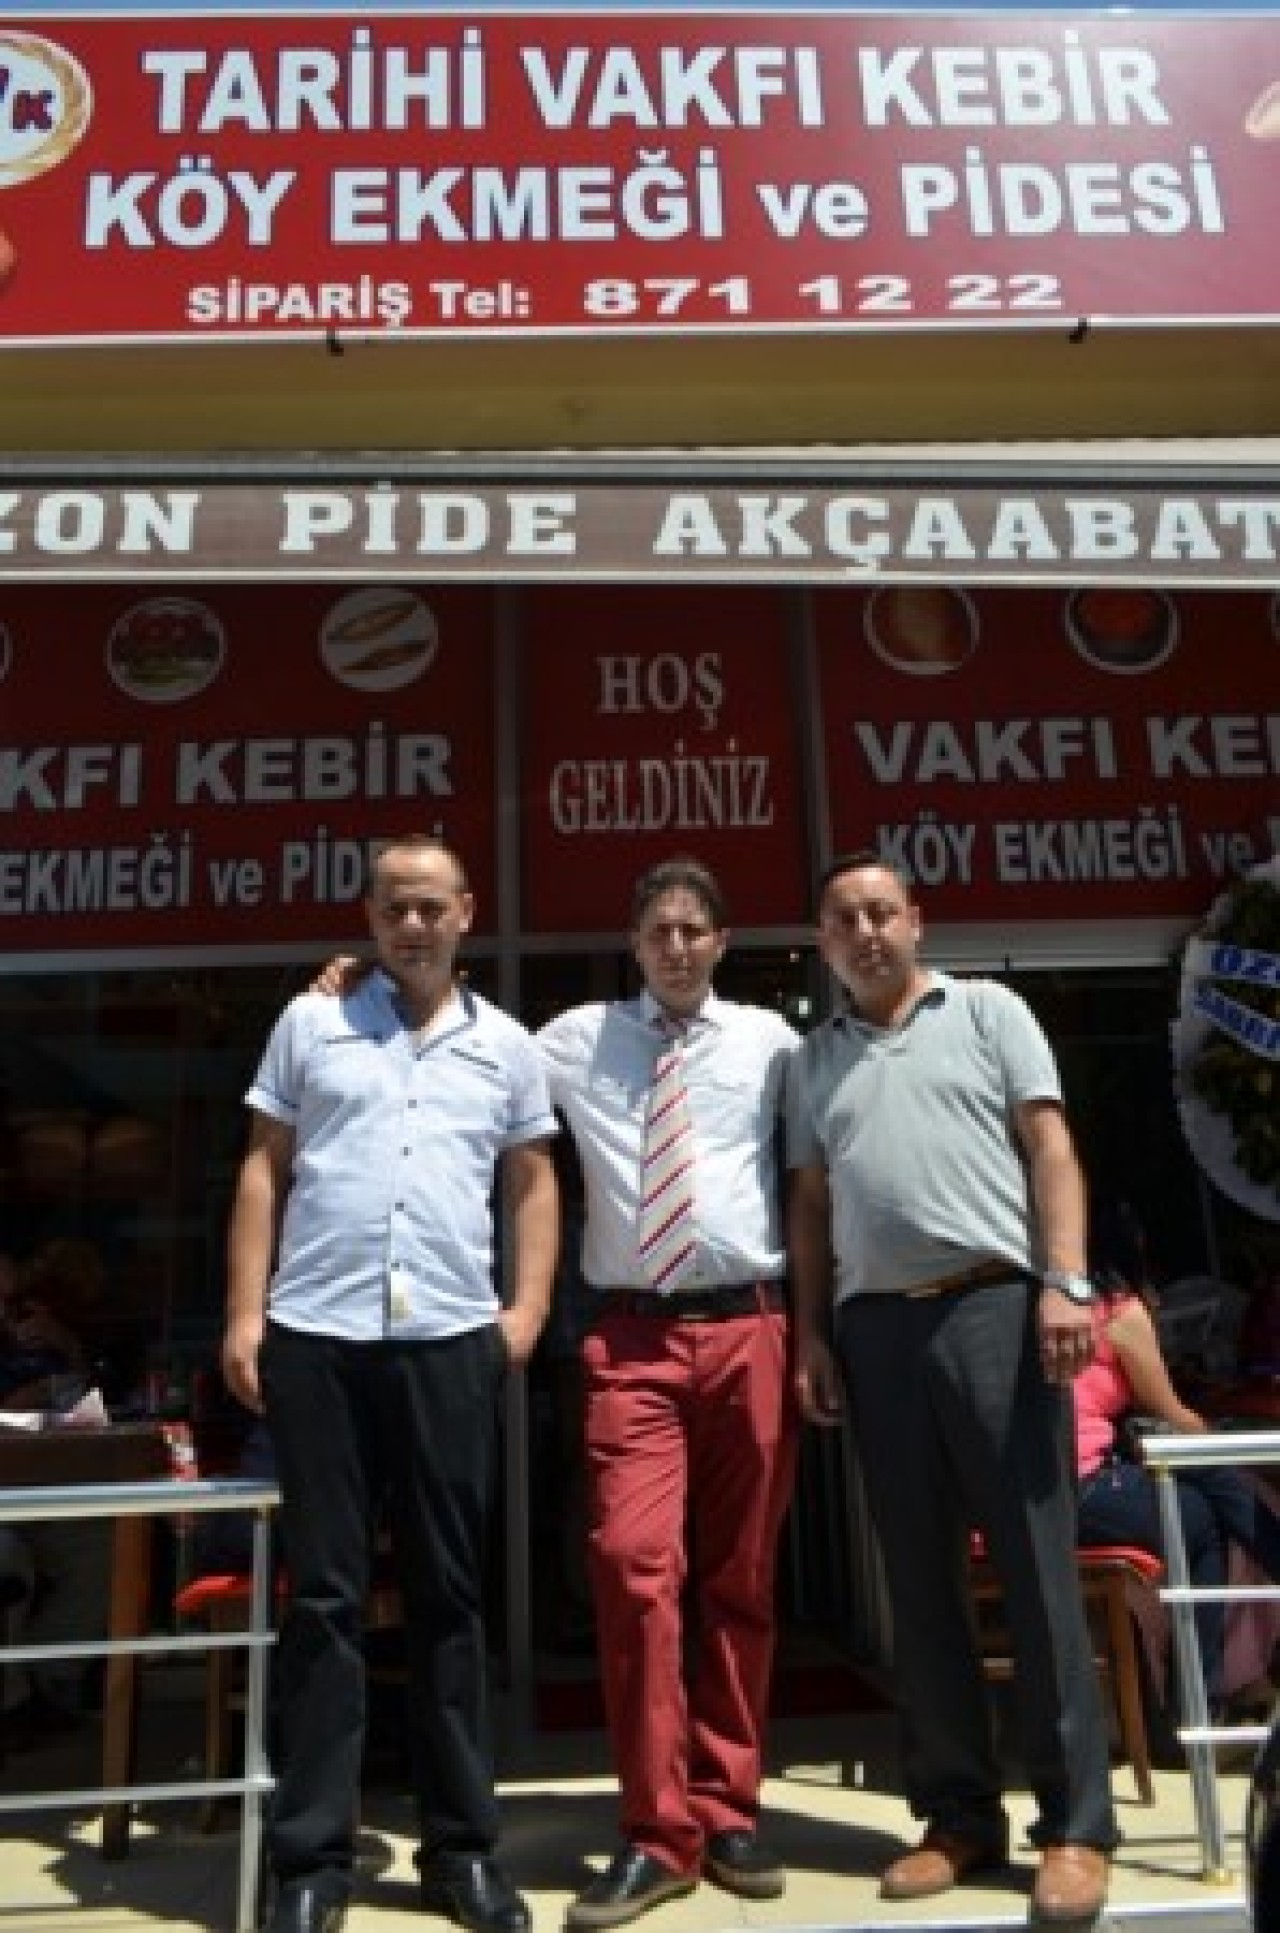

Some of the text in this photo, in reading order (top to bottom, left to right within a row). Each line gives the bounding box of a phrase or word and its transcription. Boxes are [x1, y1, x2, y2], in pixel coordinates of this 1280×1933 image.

[140, 26, 1172, 134] TARİHİ VAKFI KEBİR
[84, 145, 1225, 249] KÖY EKMEĞİ ve PİDESİ
[186, 274, 1064, 328] SİPARİŞ Tel: 871 12 22
[278, 481, 577, 555] PİDE
[597, 652, 725, 731] HOŞ
[176, 720, 453, 804] KEBİR
[549, 737, 774, 834] GELDİNİZ
[854, 715, 1117, 784] VAKFI
[0, 832, 193, 914] EKMEĞİ
[209, 857, 264, 904] ve
[995, 803, 1188, 884] EKMEĞİ
